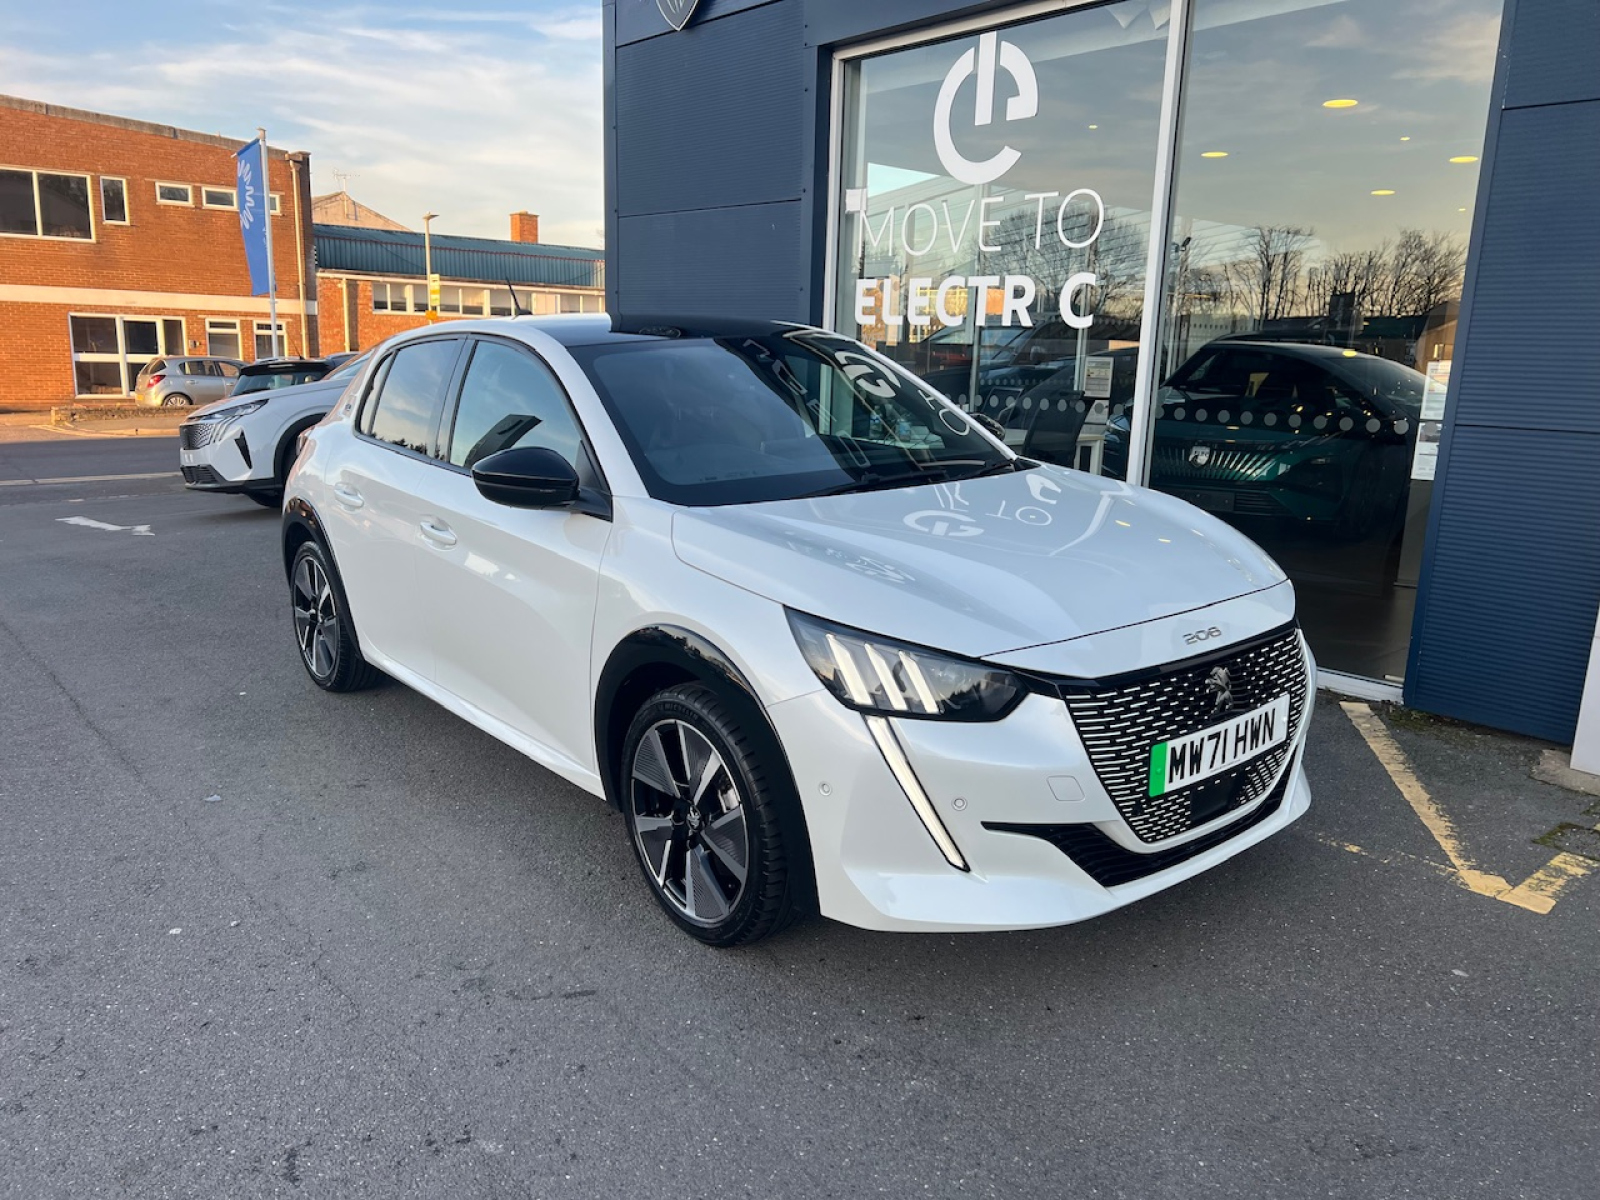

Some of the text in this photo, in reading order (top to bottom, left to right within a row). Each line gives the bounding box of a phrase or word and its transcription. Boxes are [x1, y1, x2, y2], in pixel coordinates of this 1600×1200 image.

[858, 188, 1105, 258] MOVE TO
[1182, 626, 1222, 645] 208
[1168, 707, 1276, 784] MW71 HWN
